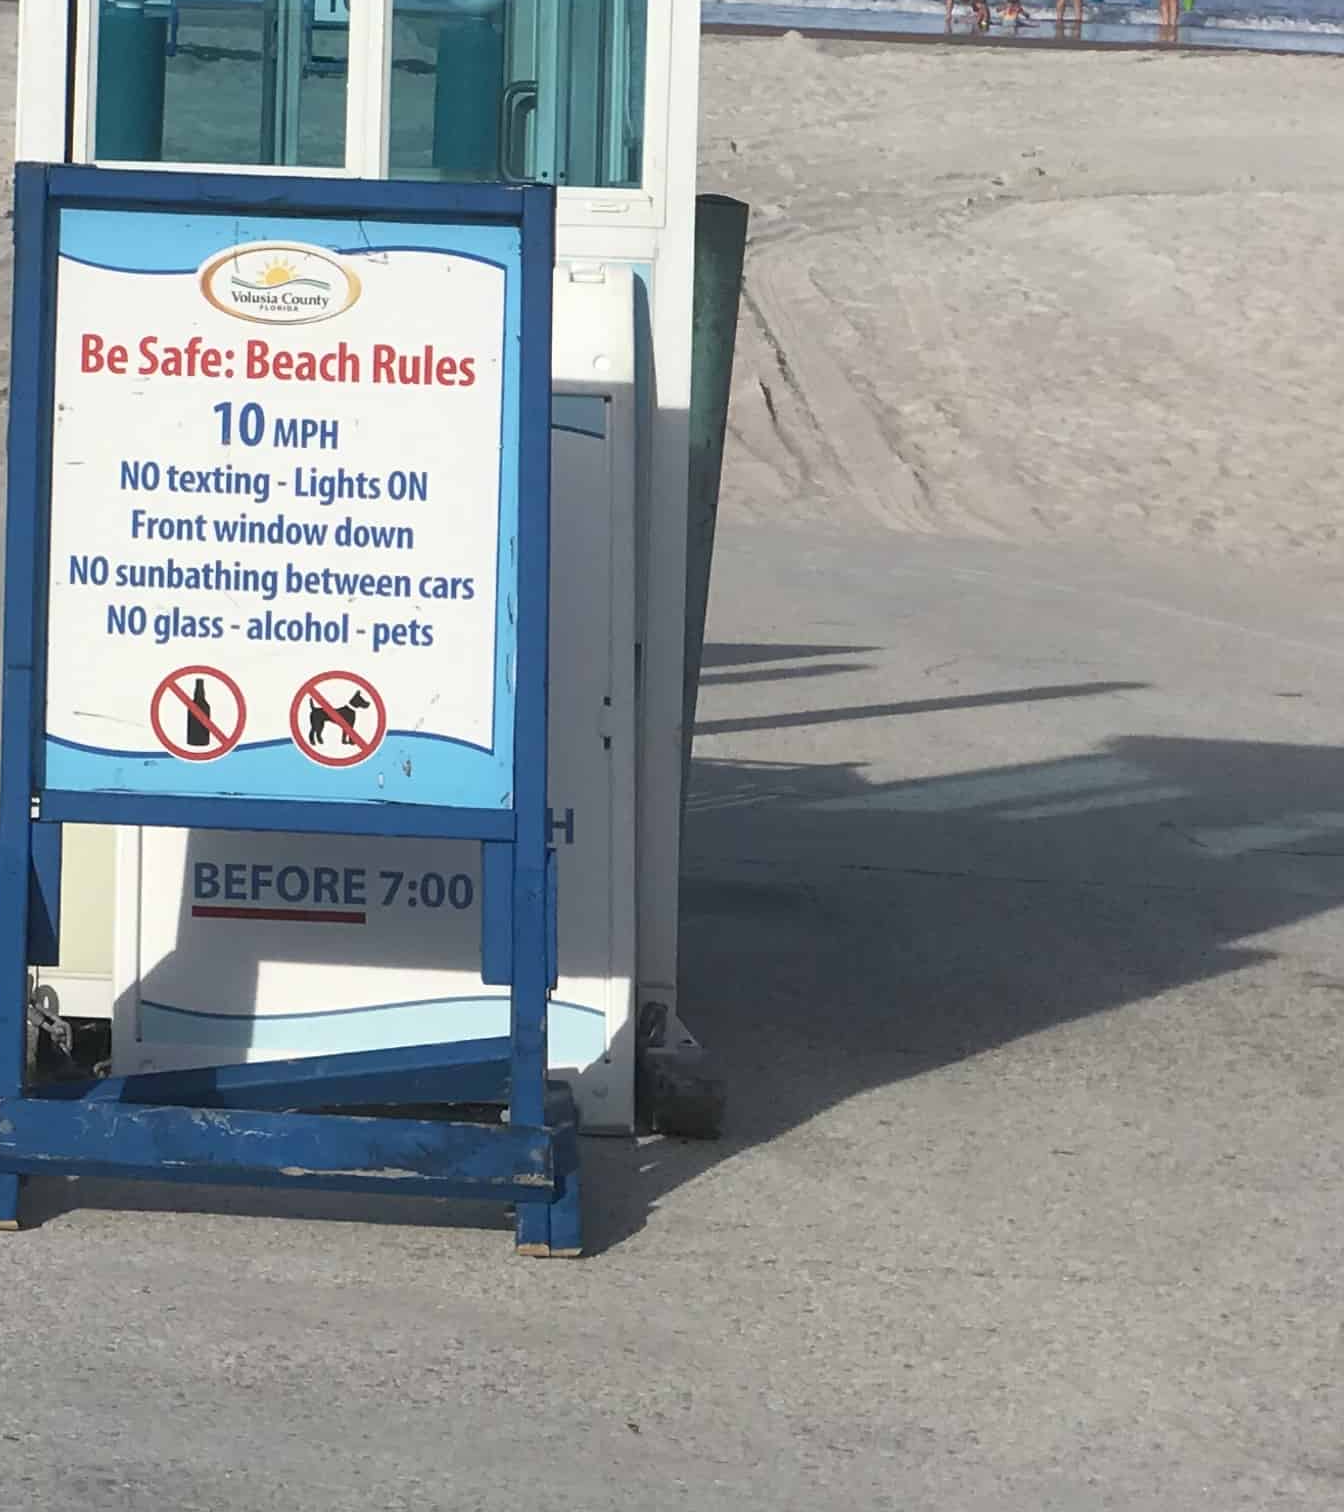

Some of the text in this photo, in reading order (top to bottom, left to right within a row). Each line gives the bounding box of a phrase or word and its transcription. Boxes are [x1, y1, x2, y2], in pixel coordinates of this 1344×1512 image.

[231, 291, 330, 309] Volusia County
[81, 333, 476, 387] Be Safe: Beach Rules
[213, 401, 339, 450] 10 MPH
[120, 460, 160, 491] NO
[166, 464, 270, 504] texting
[295, 467, 381, 506] Lights
[387, 470, 428, 502] ON
[131, 509, 414, 550] Front window down
[69, 555, 475, 601] NO sunbathing between cars
[107, 604, 147, 636] NO
[153, 606, 224, 645] glass
[246, 610, 349, 644] alcohol
[372, 619, 434, 653] pets
[194, 862, 474, 910] BEFORE 7:00
